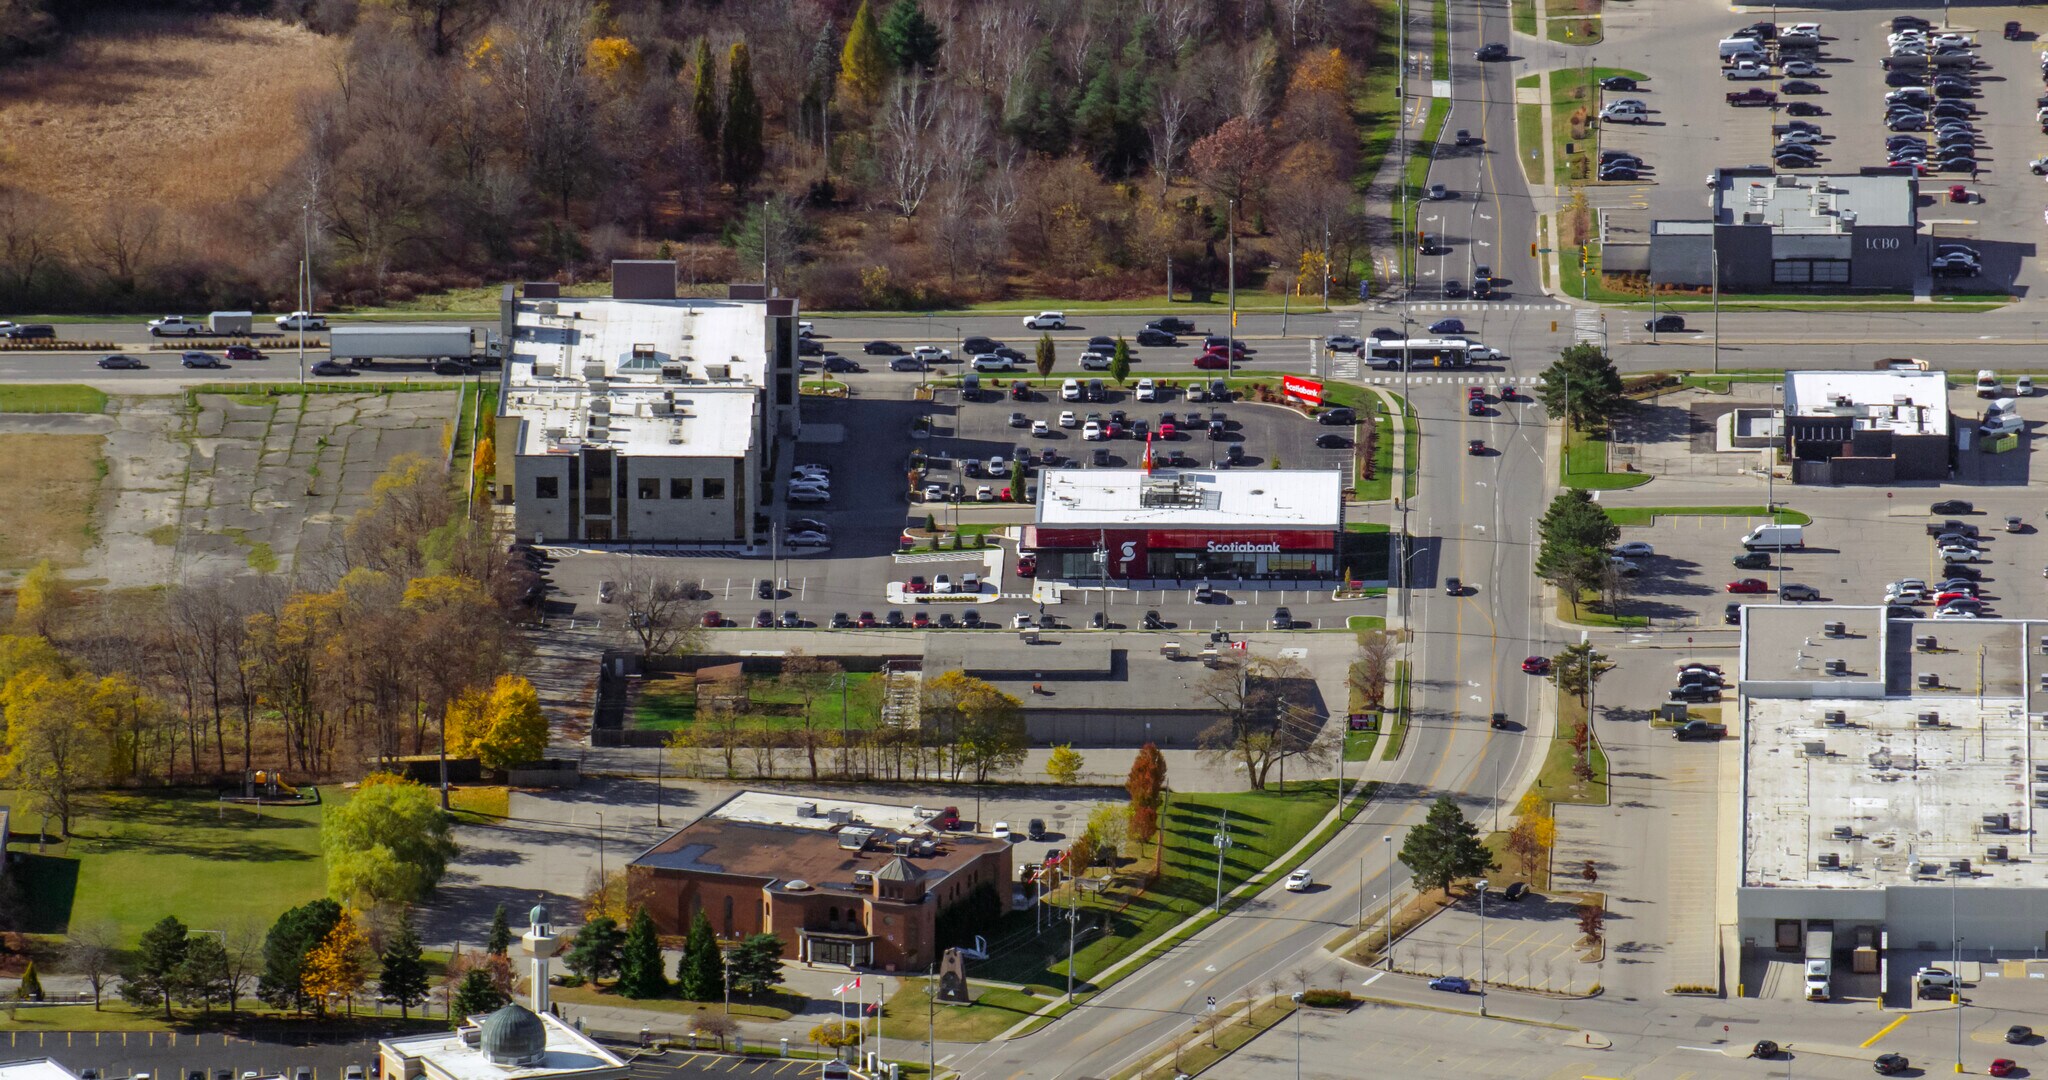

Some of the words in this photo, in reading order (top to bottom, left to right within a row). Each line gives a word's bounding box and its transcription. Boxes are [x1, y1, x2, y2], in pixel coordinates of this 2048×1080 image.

[1866, 237, 1900, 250] LCBO
[1286, 382, 1318, 397] Scotiabank
[1207, 540, 1281, 553] Scotiabank
